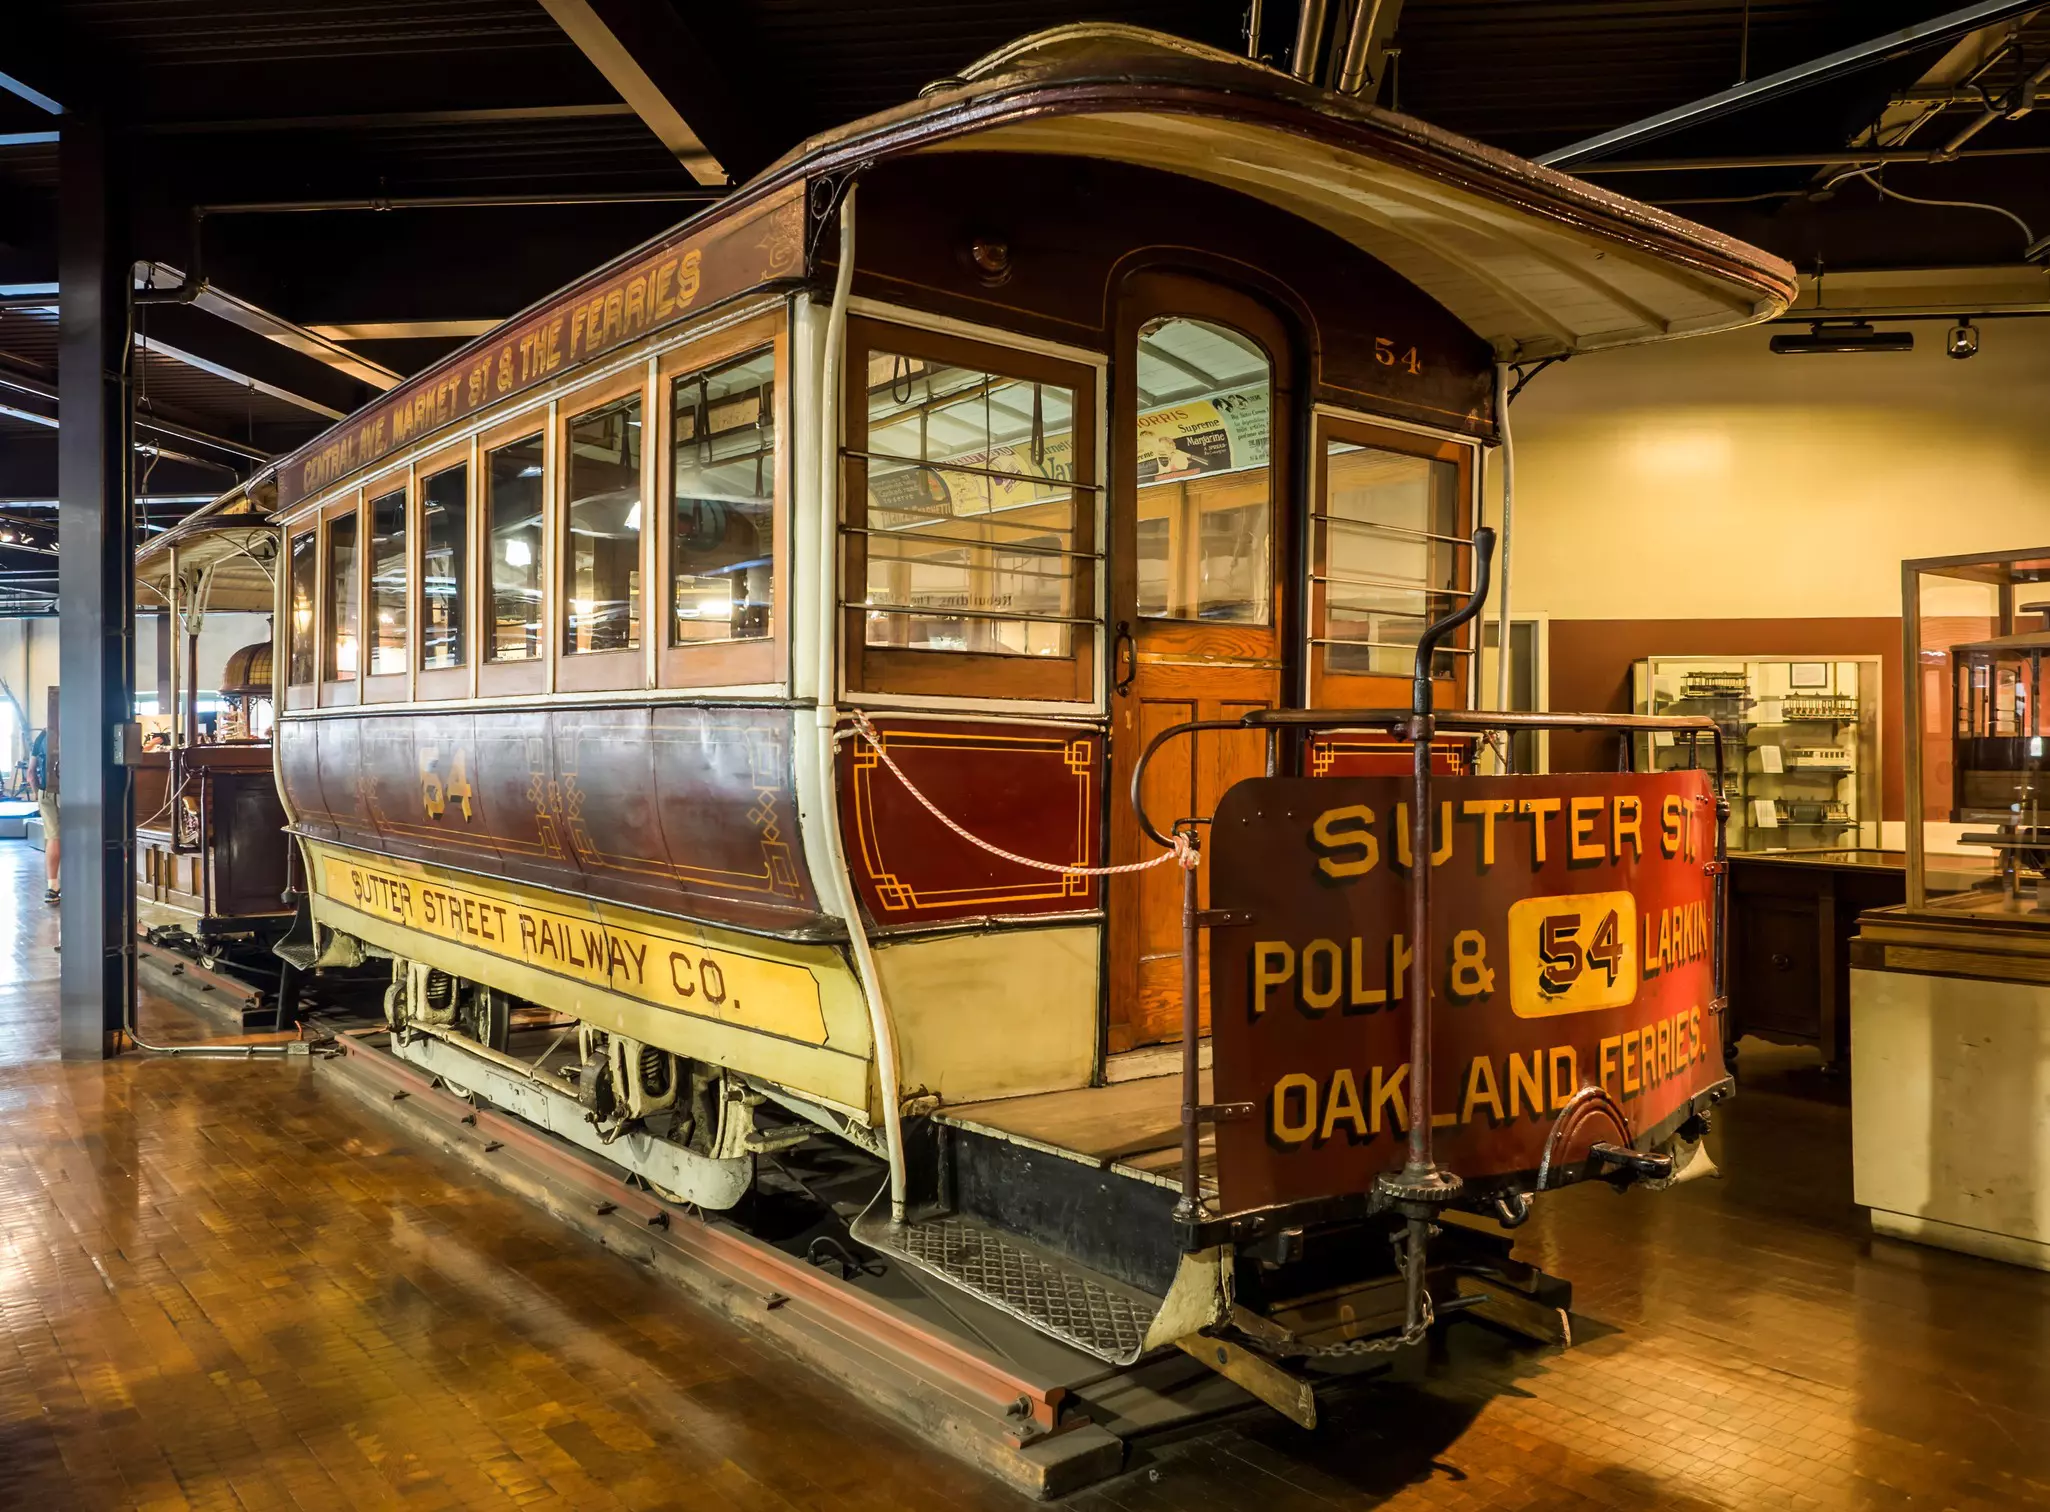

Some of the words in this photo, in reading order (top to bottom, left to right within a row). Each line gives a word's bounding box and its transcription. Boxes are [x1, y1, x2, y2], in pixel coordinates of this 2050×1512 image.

[303, 435, 357, 492] CENTRAL
[392, 372, 462, 445] MARKET
[497, 346, 515, 392] &
[519, 315, 564, 382] THE
[569, 249, 702, 360] FERRIES
[1375, 336, 1422, 375] 54
[1178, 419, 1220, 434] Supreme
[1186, 431, 1226, 447] Margarine
[418, 746, 473, 825] 54
[1311, 795, 1644, 879] SUTTER
[351, 869, 414, 918] SUTTER
[422, 889, 507, 943] STREET
[518, 913, 648, 985] RAILWAY
[668, 950, 741, 1010] CO.
[1450, 929, 1495, 997] &
[1538, 907, 1624, 996] 54
[1643, 899, 1708, 973] LARKIN
[1600, 1005, 1707, 1100] FERRIES.
